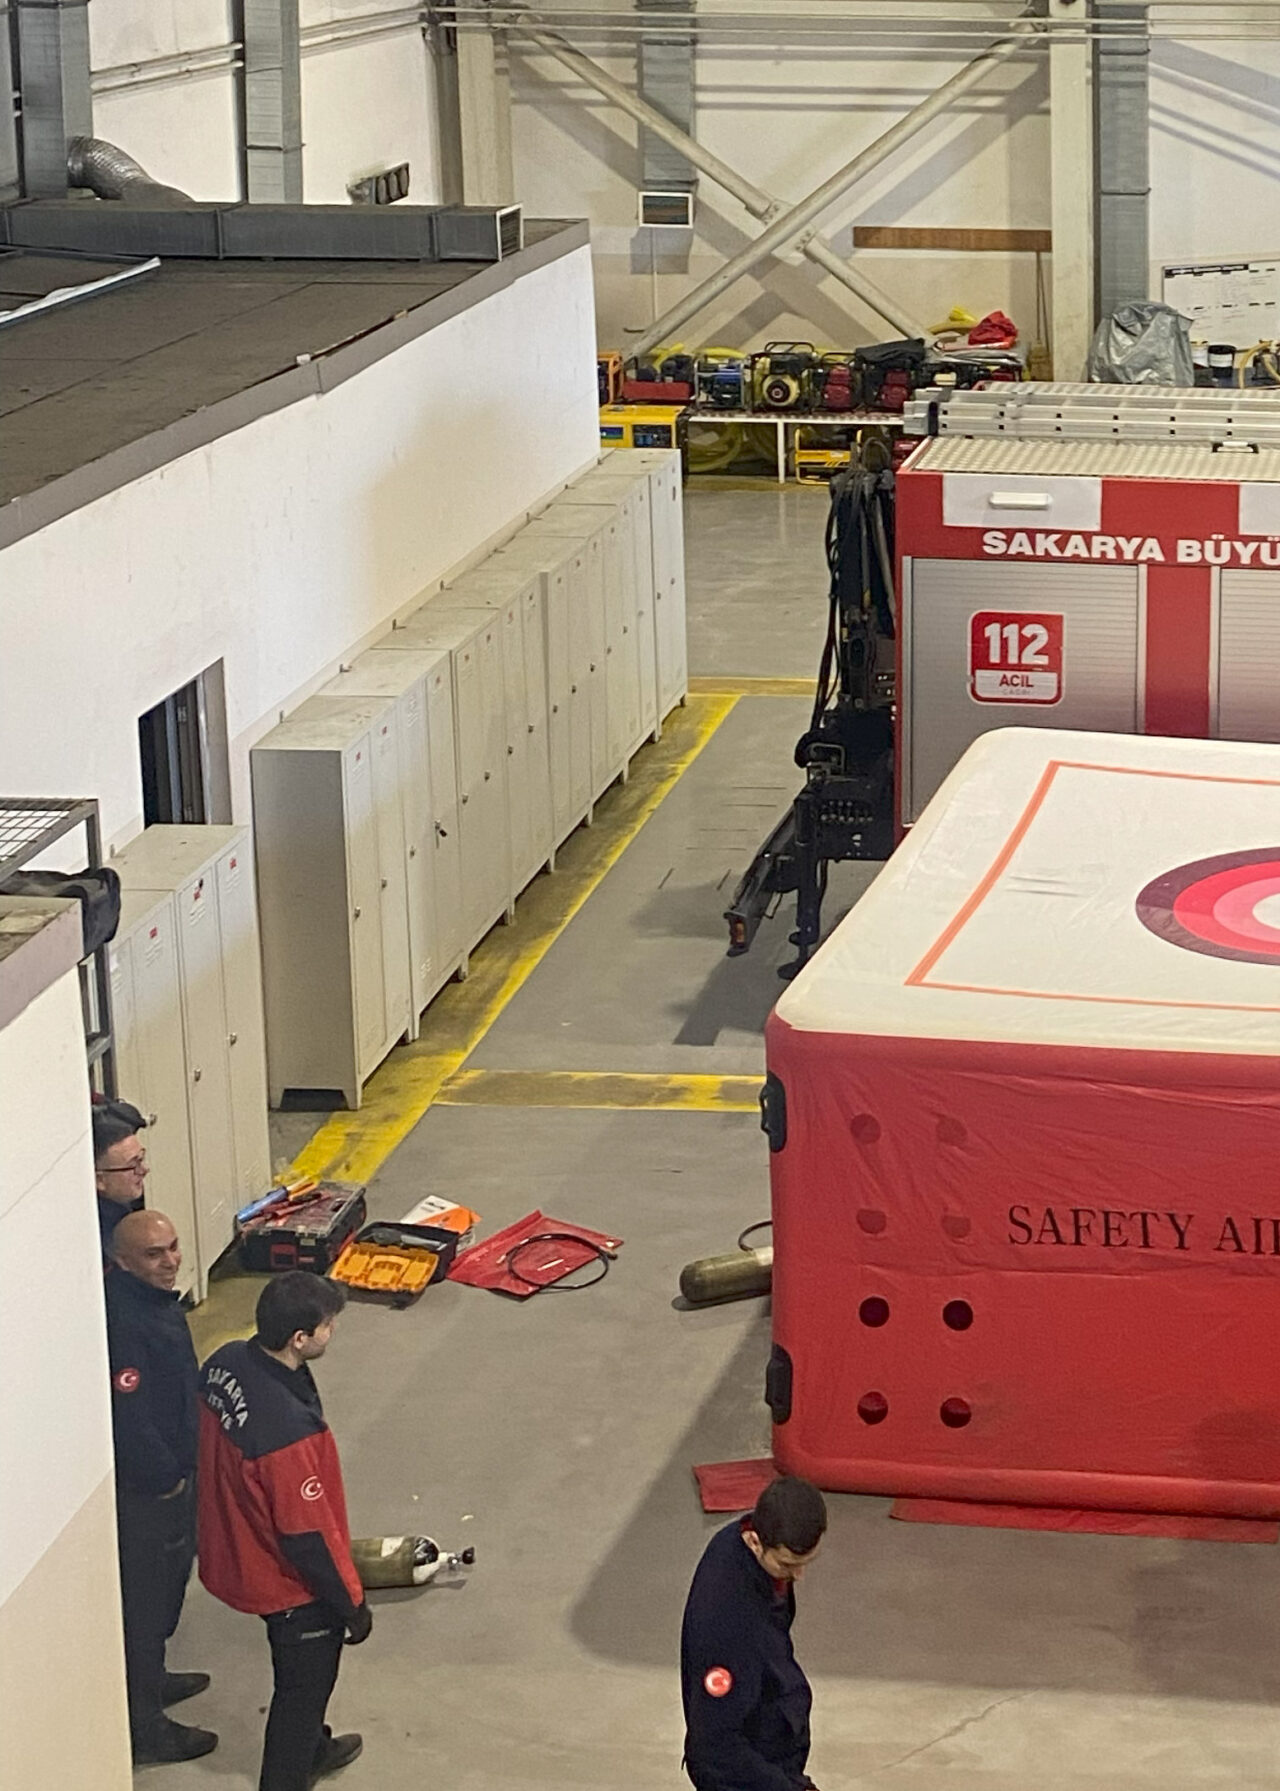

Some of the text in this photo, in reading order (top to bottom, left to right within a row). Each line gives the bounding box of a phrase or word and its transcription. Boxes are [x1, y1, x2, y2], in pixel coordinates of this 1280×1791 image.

[982, 531, 1165, 562] SAKARYA
[984, 622, 1049, 665] 112
[1008, 1204, 1195, 1250] SAFETY
